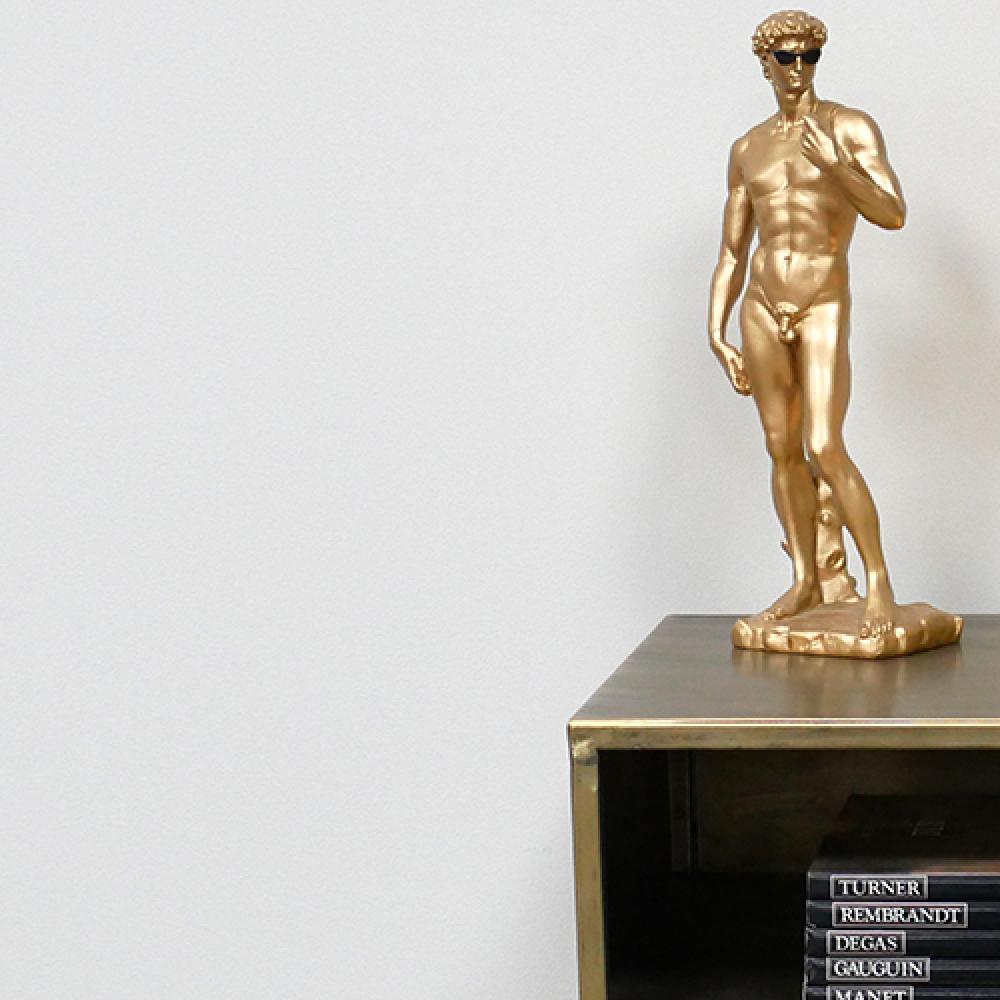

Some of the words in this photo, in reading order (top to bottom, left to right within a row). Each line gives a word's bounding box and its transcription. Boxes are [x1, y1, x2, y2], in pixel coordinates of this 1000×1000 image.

[838, 879, 921, 896] TURNER
[841, 906, 961, 923] REMBRANDT
[835, 935, 898, 951] DEGAS
[833, 960, 923, 976] GAUGUIN
